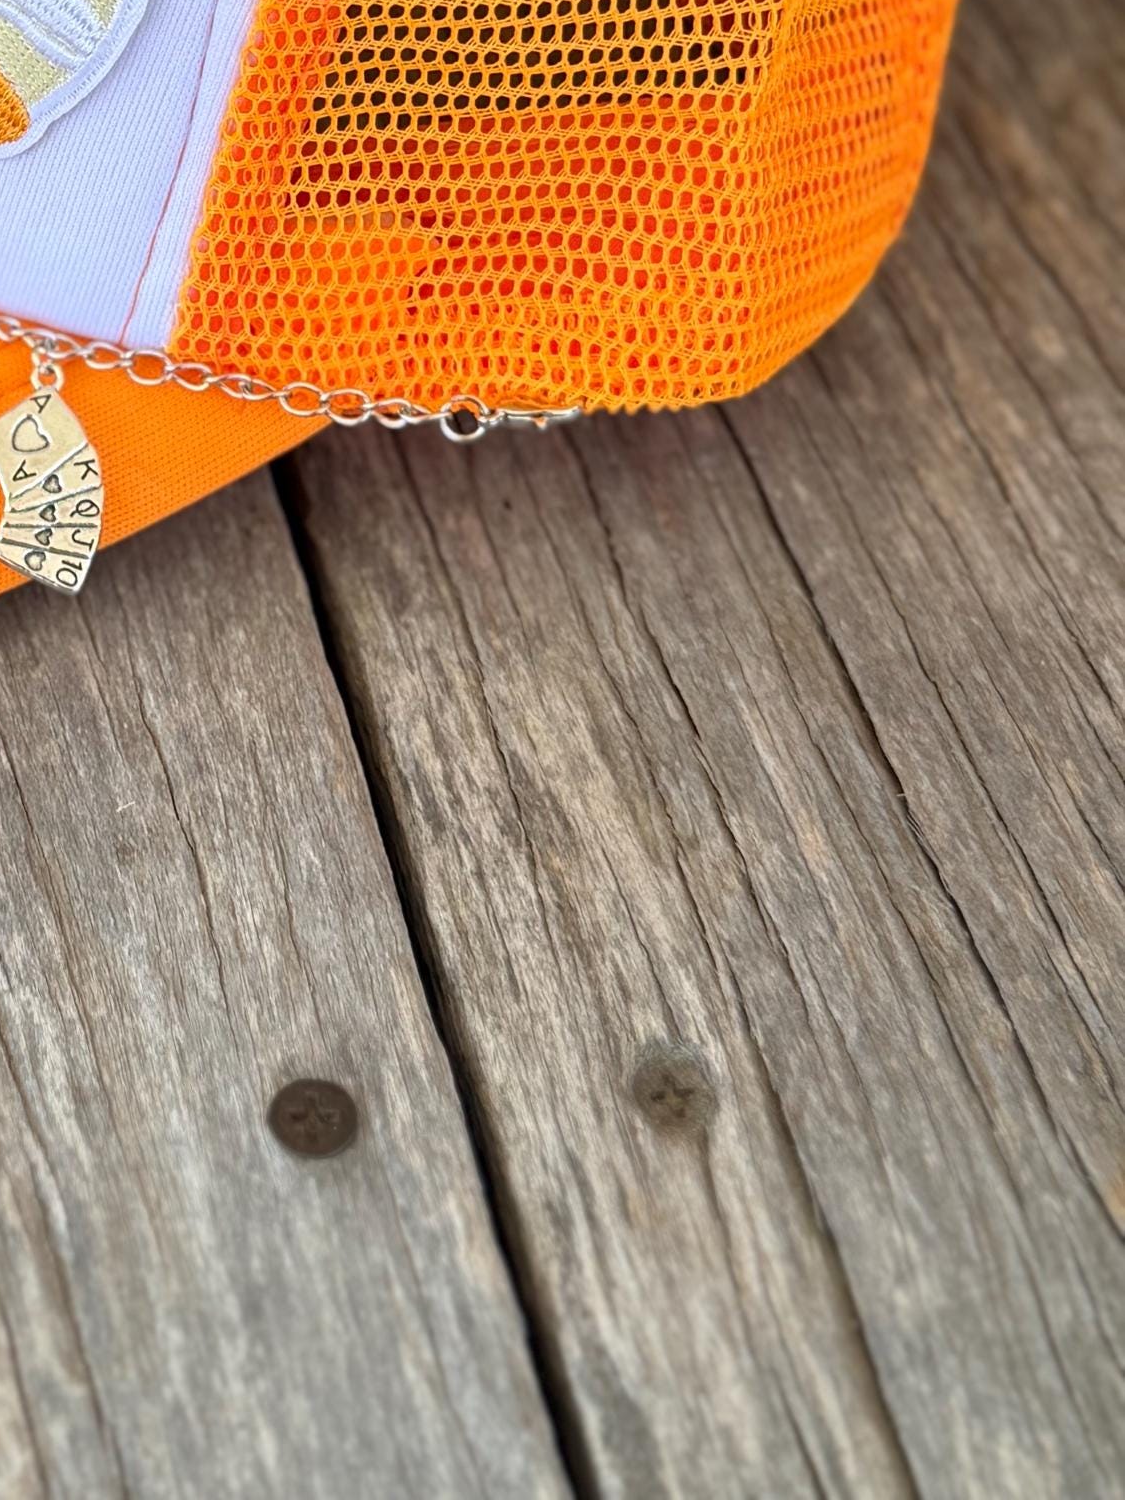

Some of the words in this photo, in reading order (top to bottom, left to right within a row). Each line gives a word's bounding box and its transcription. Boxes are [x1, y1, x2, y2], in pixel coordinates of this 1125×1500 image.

[30, 394, 52, 414] A
[12, 460, 37, 481] A
[73, 459, 99, 480] K
[69, 499, 100, 518] Q
[71, 529, 95, 552] J
[56, 559, 83, 588] 10
